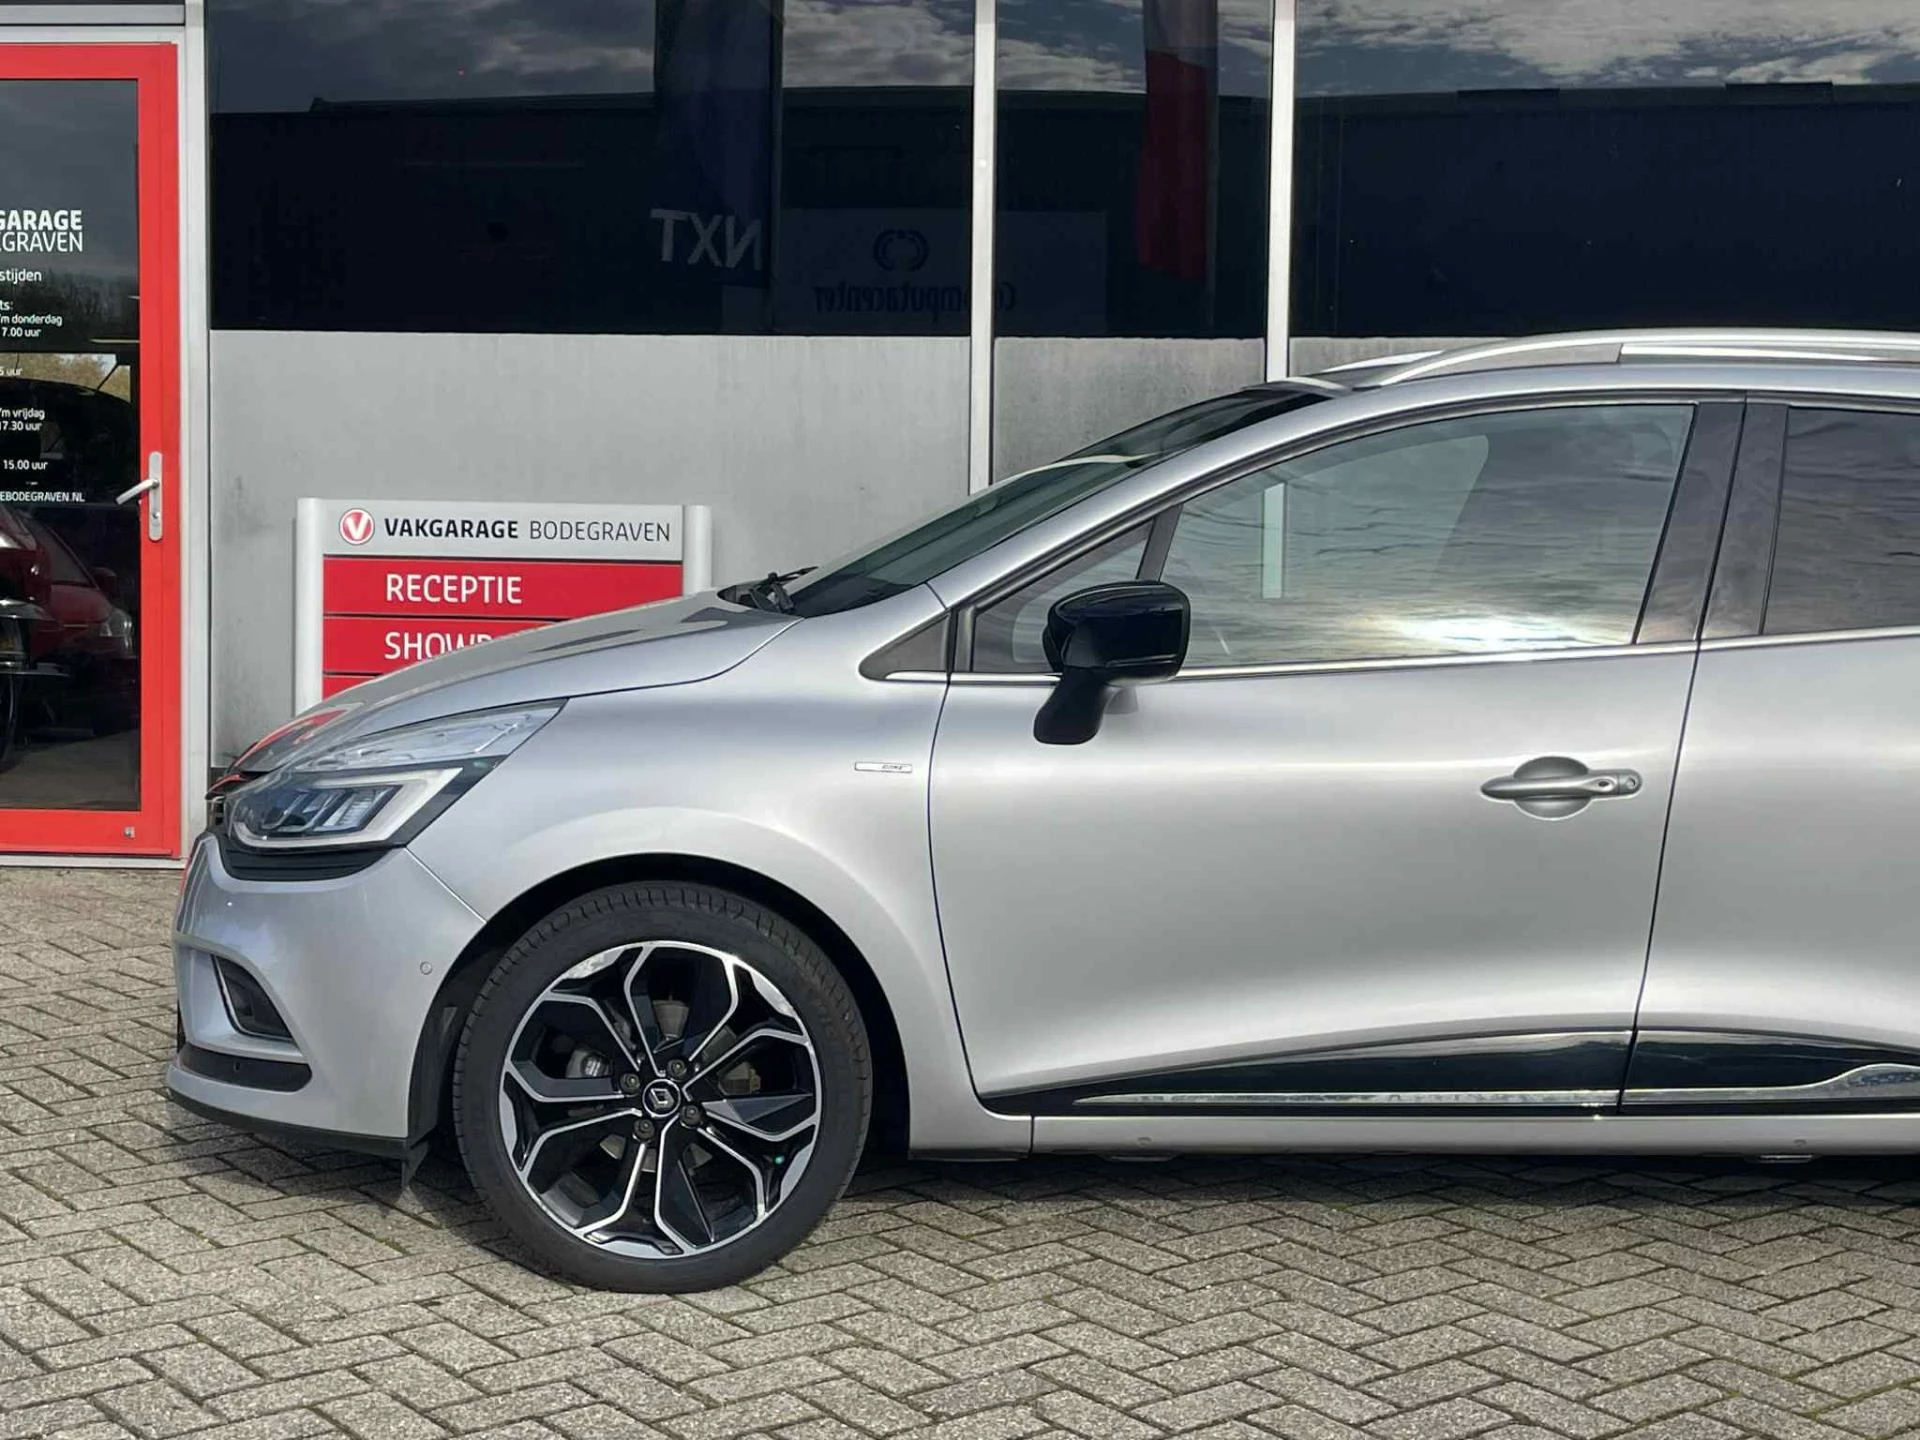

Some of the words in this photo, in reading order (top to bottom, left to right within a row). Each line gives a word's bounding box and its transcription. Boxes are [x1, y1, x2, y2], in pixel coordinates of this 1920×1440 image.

[0, 231, 83, 252] GRAVEN
[11, 313, 63, 327] donderdag
[24, 328, 41, 337] uur
[12, 407, 45, 420] vrijdag
[25, 422, 42, 431] uur
[3, 459, 30, 470] 15.00
[31, 461, 48, 470] uur
[384, 517, 519, 539] VAKGARAGE
[529, 520, 671, 542] BODEGRAVEN
[385, 573, 522, 604] RECEPTIE
